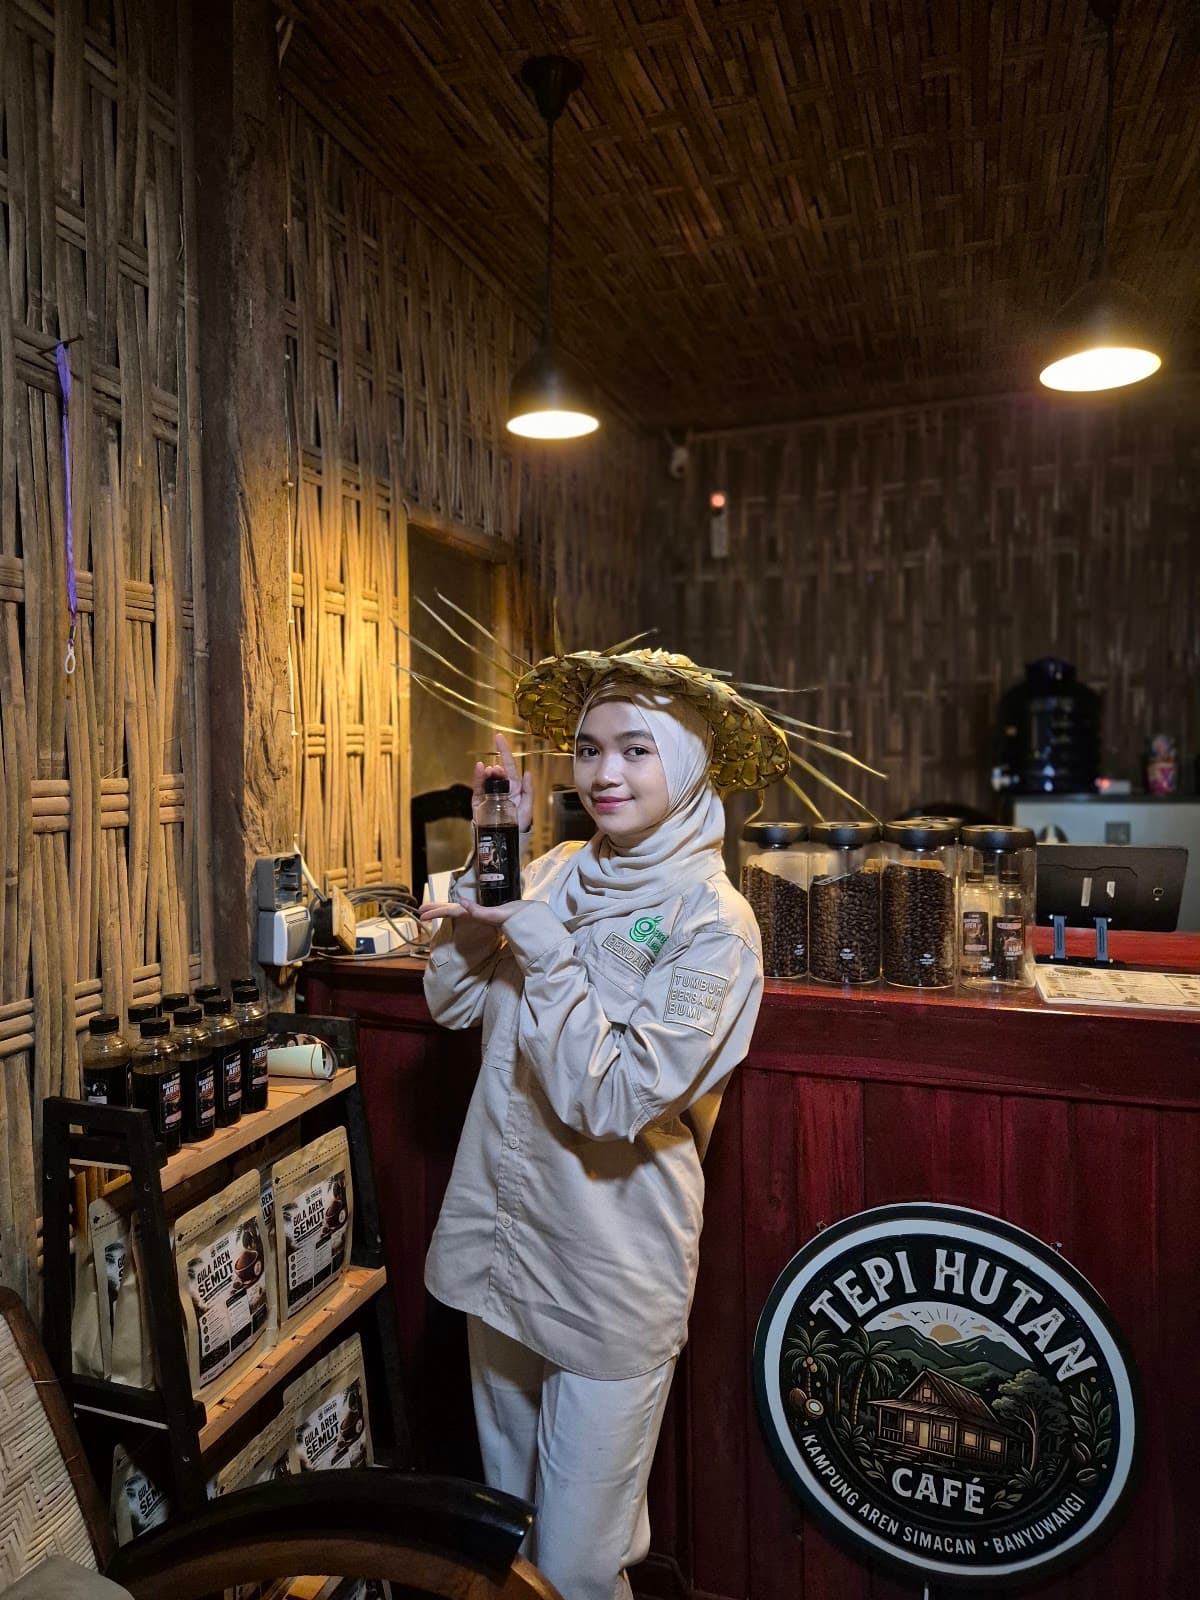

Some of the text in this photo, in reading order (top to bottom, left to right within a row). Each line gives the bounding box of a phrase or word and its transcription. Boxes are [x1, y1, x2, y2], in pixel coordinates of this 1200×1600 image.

[668, 1002, 702, 1021] BUMI
[671, 989, 717, 1012] BERSAMA
[261, 1191, 273, 1207] REN
[293, 1209, 307, 1227] GULA
[308, 1198, 324, 1217] AREN
[293, 1207, 325, 1239] SEMUT
[197, 1249, 231, 1285] GULA AREN
[198, 1260, 233, 1298] SEMUT
[809, 1248, 1098, 1383] TEPI HUTAN
[304, 1411, 338, 1447] GULA AREN
[306, 1420, 340, 1459] SEMUT
[802, 1433, 1086, 1556] KAMPUNG AREN SIMACAN BANYUWANGI
[891, 1467, 985, 1515] CAFÉ
